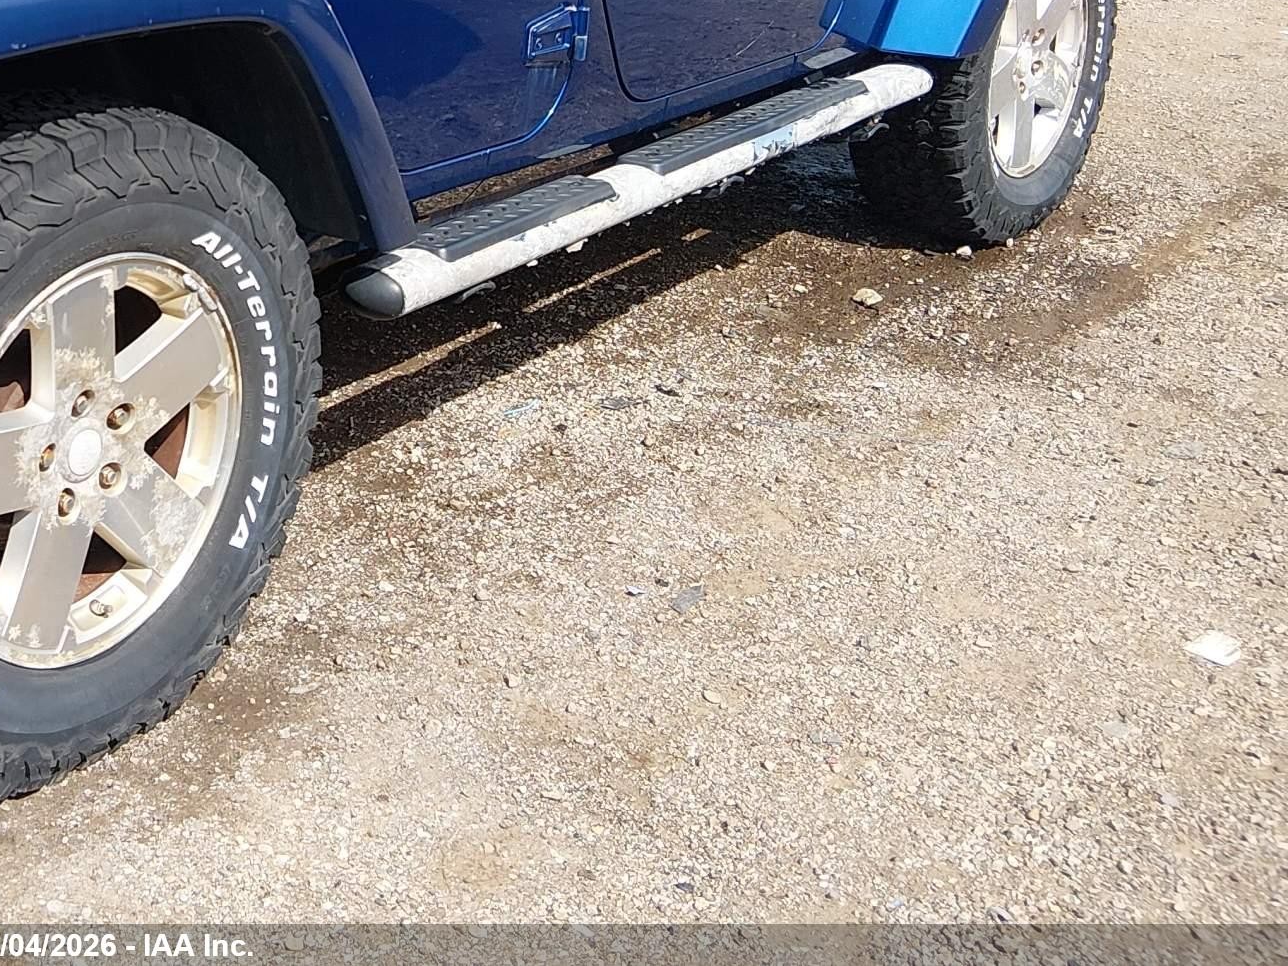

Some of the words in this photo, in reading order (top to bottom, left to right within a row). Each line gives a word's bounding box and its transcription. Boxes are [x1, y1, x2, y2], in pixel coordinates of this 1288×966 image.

[1073, 97, 1093, 139] T/A
[192, 231, 280, 447] All-Terrain
[228, 474, 269, 550] T/A
